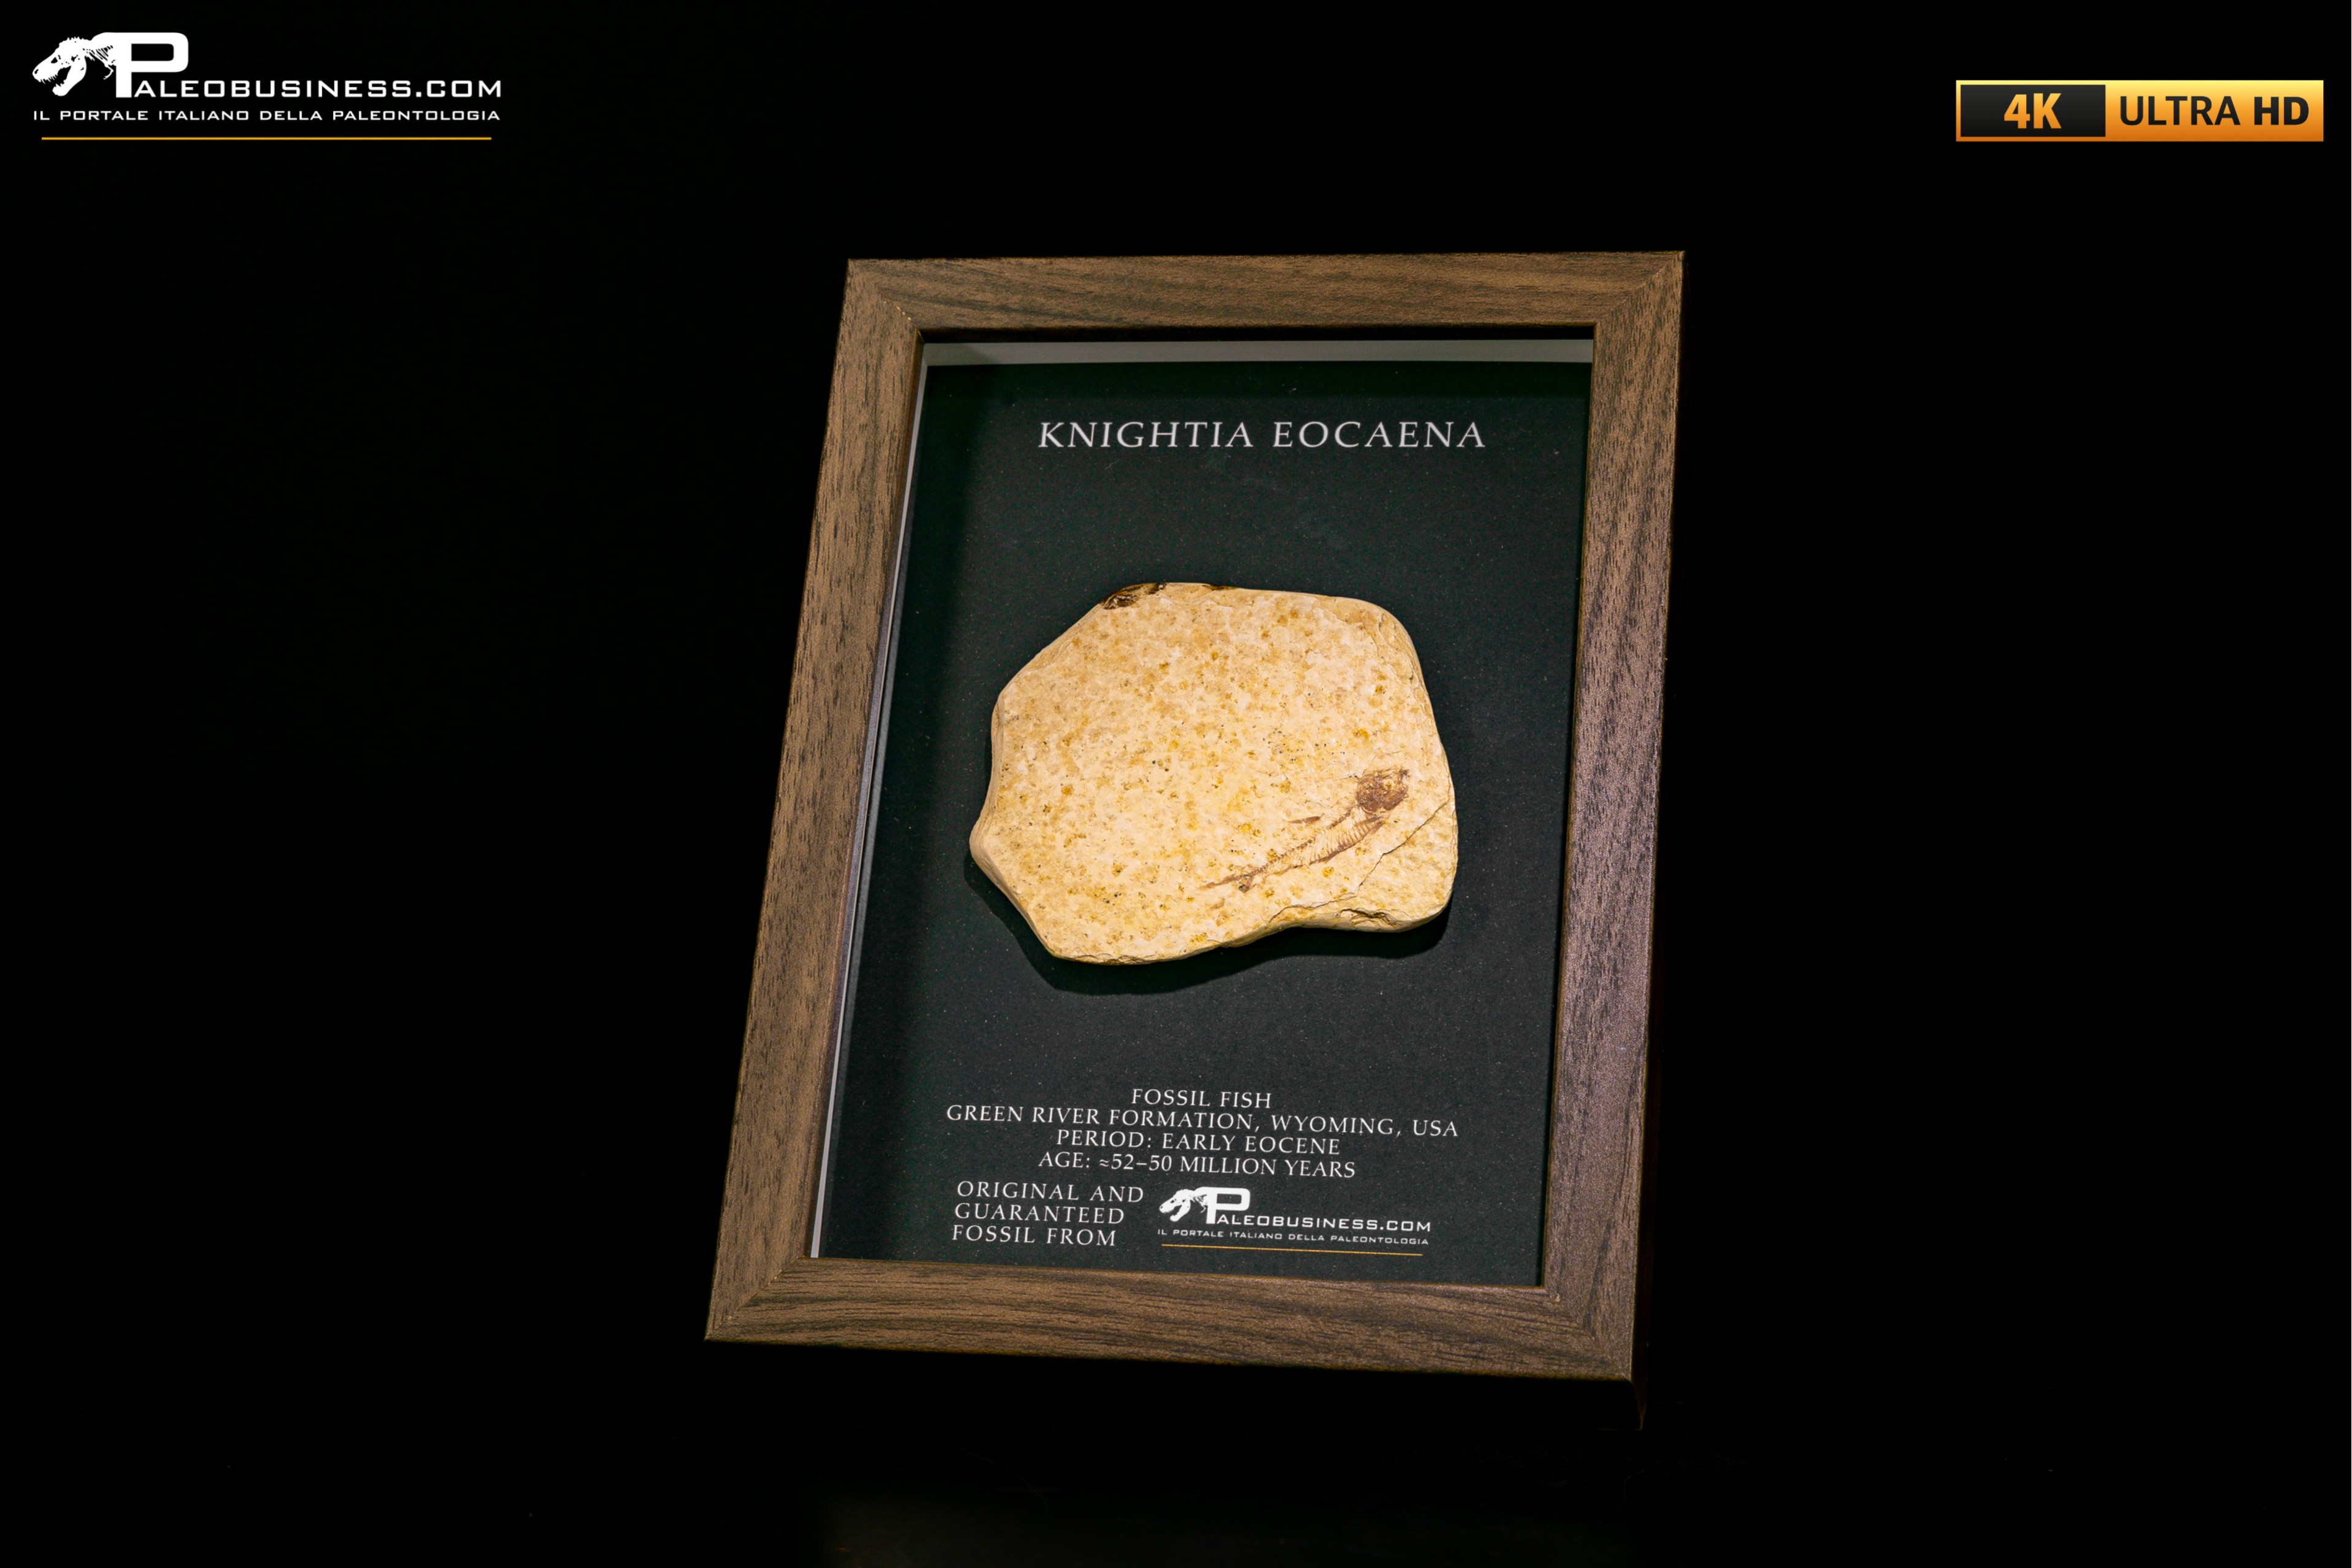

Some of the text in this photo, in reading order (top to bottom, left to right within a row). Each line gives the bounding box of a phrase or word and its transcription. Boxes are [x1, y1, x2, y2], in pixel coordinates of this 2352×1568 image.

[1038, 421, 1486, 448] KNIGHTIA EOCAENA
[1131, 1088, 1272, 1109] FOSSIL FISH
[946, 1104, 1458, 1137] GREEN RIVER FORMATION, WYOMING, USA
[1057, 1129, 1340, 1155] PERIOD: EARLY EOCENE
[1038, 1151, 1090, 1168] AGE:
[1180, 1156, 1277, 1175] MILLION
[1284, 1159, 1355, 1178] YEARS
[957, 1180, 1144, 1203] ORIGINAL AND
[954, 1202, 1125, 1224] GUARANTEED
[1205, 1186, 1431, 1232] PALEOBUSINESS.COM
[952, 1224, 1116, 1246] FOSSIL FROM
[1172, 1229, 1224, 1238] PORTALE
[1229, 1231, 1283, 1240] ITALIANO
[1330, 1235, 1429, 1245] PALEONTOLOGIA
